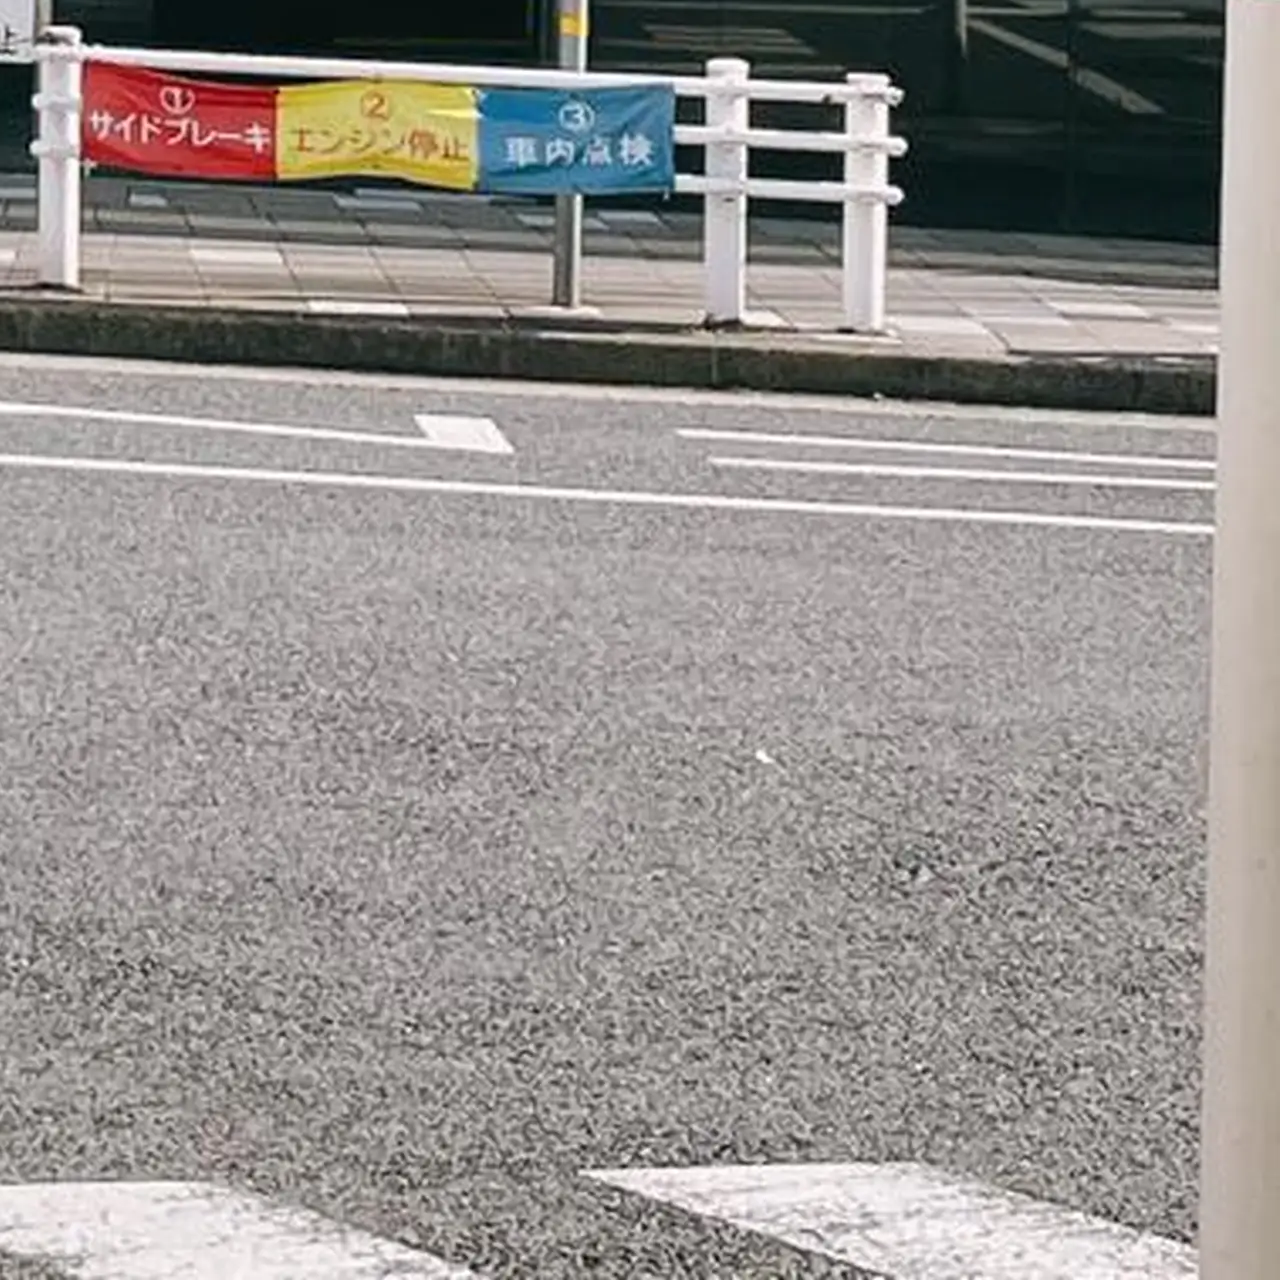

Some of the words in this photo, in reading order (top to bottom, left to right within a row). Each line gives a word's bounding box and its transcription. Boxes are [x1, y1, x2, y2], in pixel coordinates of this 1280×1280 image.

[90, 110, 272, 154] サイドブレーキ
[503, 136, 655, 167] 車内点検
